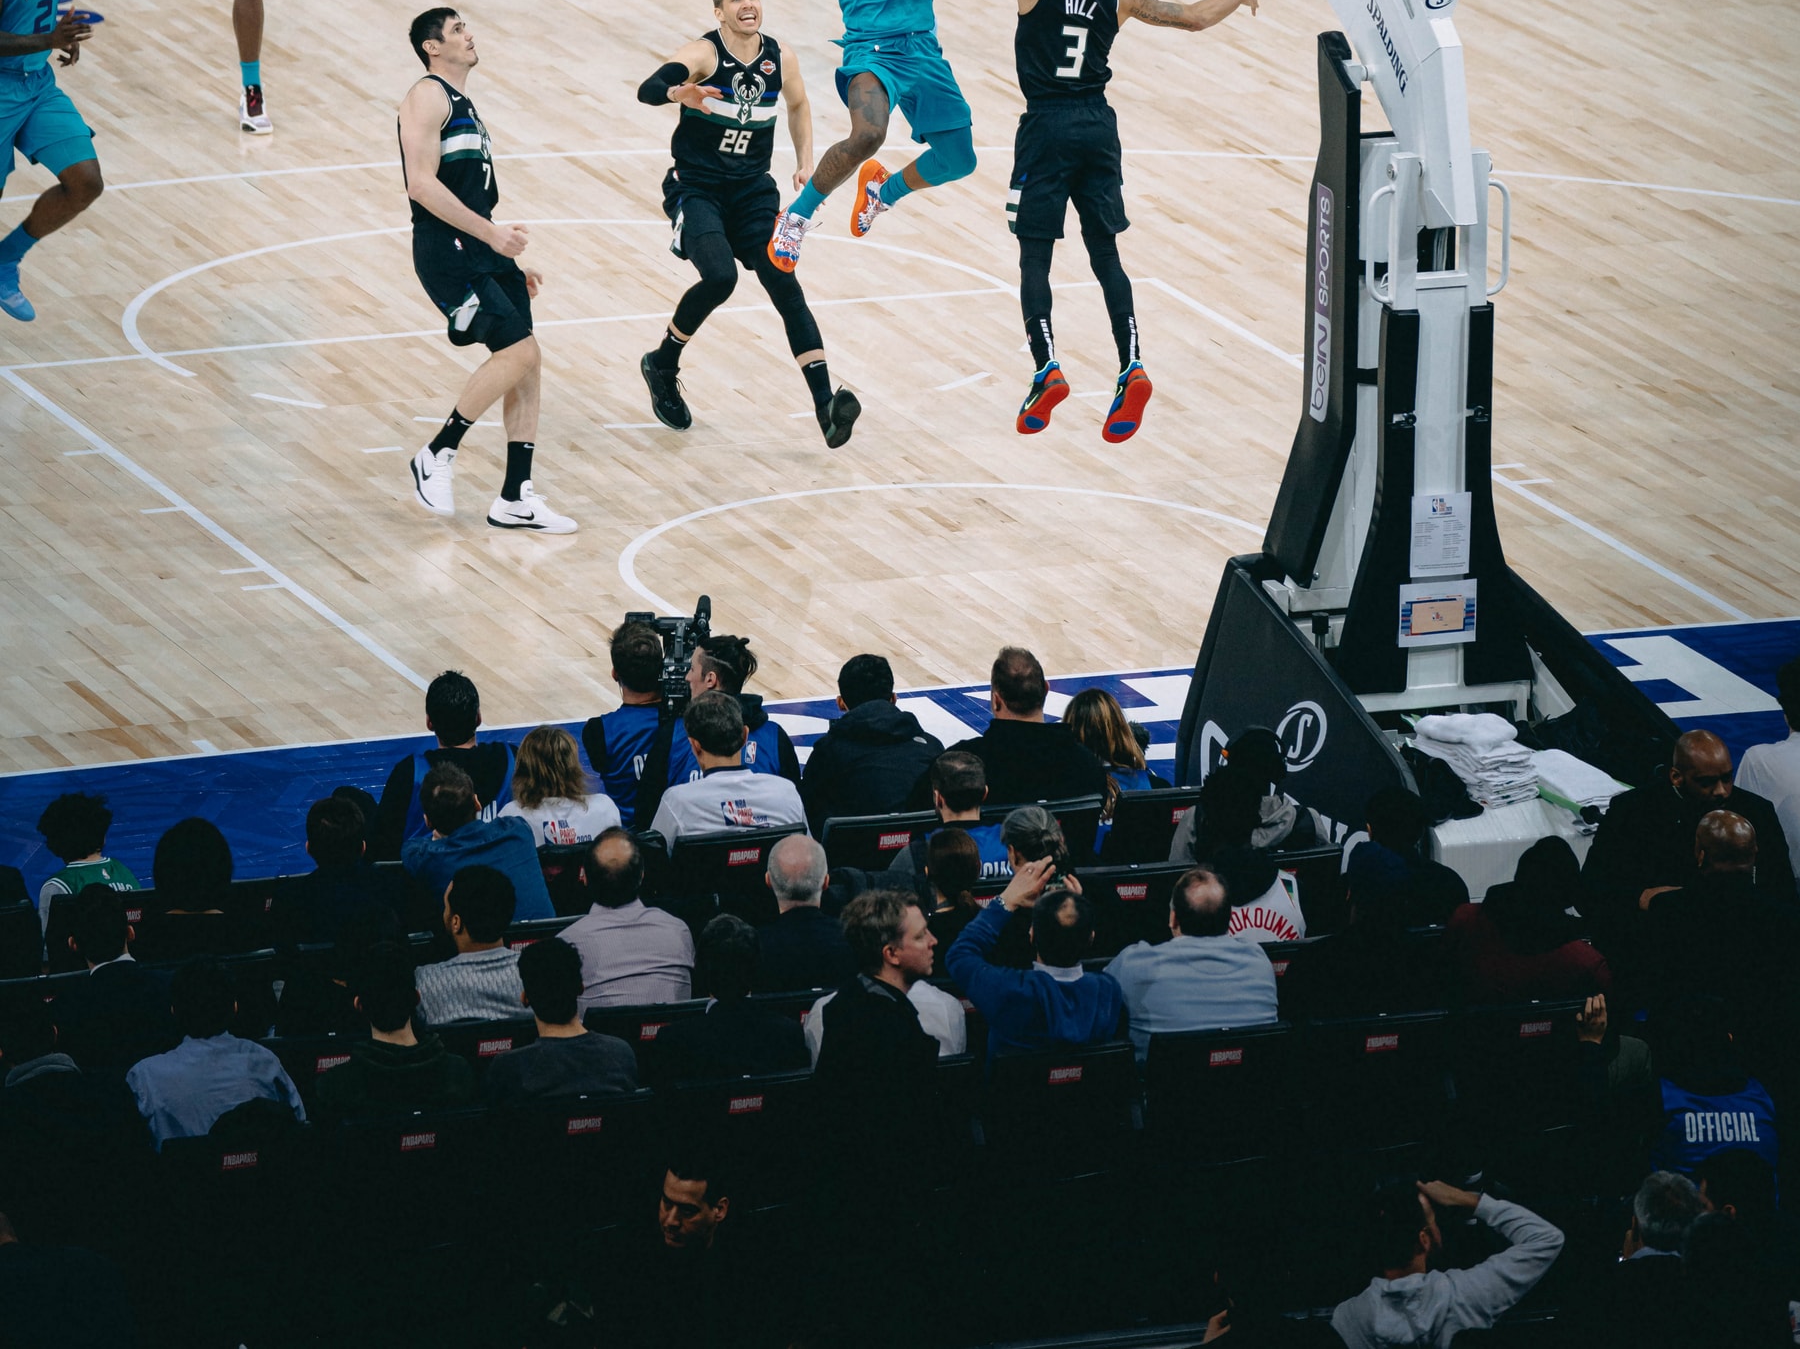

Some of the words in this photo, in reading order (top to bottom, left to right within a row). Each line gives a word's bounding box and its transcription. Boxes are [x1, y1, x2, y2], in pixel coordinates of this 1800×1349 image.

[1055, 25, 1089, 79] 3
[718, 128, 753, 155] 26
[482, 162, 491, 190] 7
[1317, 195, 1332, 307] SPORTS
[1311, 323, 1328, 412] beIN
[729, 851, 760, 864] #NBAPARIS
[1684, 1111, 1760, 1143] OFFICIAL
[223, 1152, 257, 1166] #NBAPARIS
